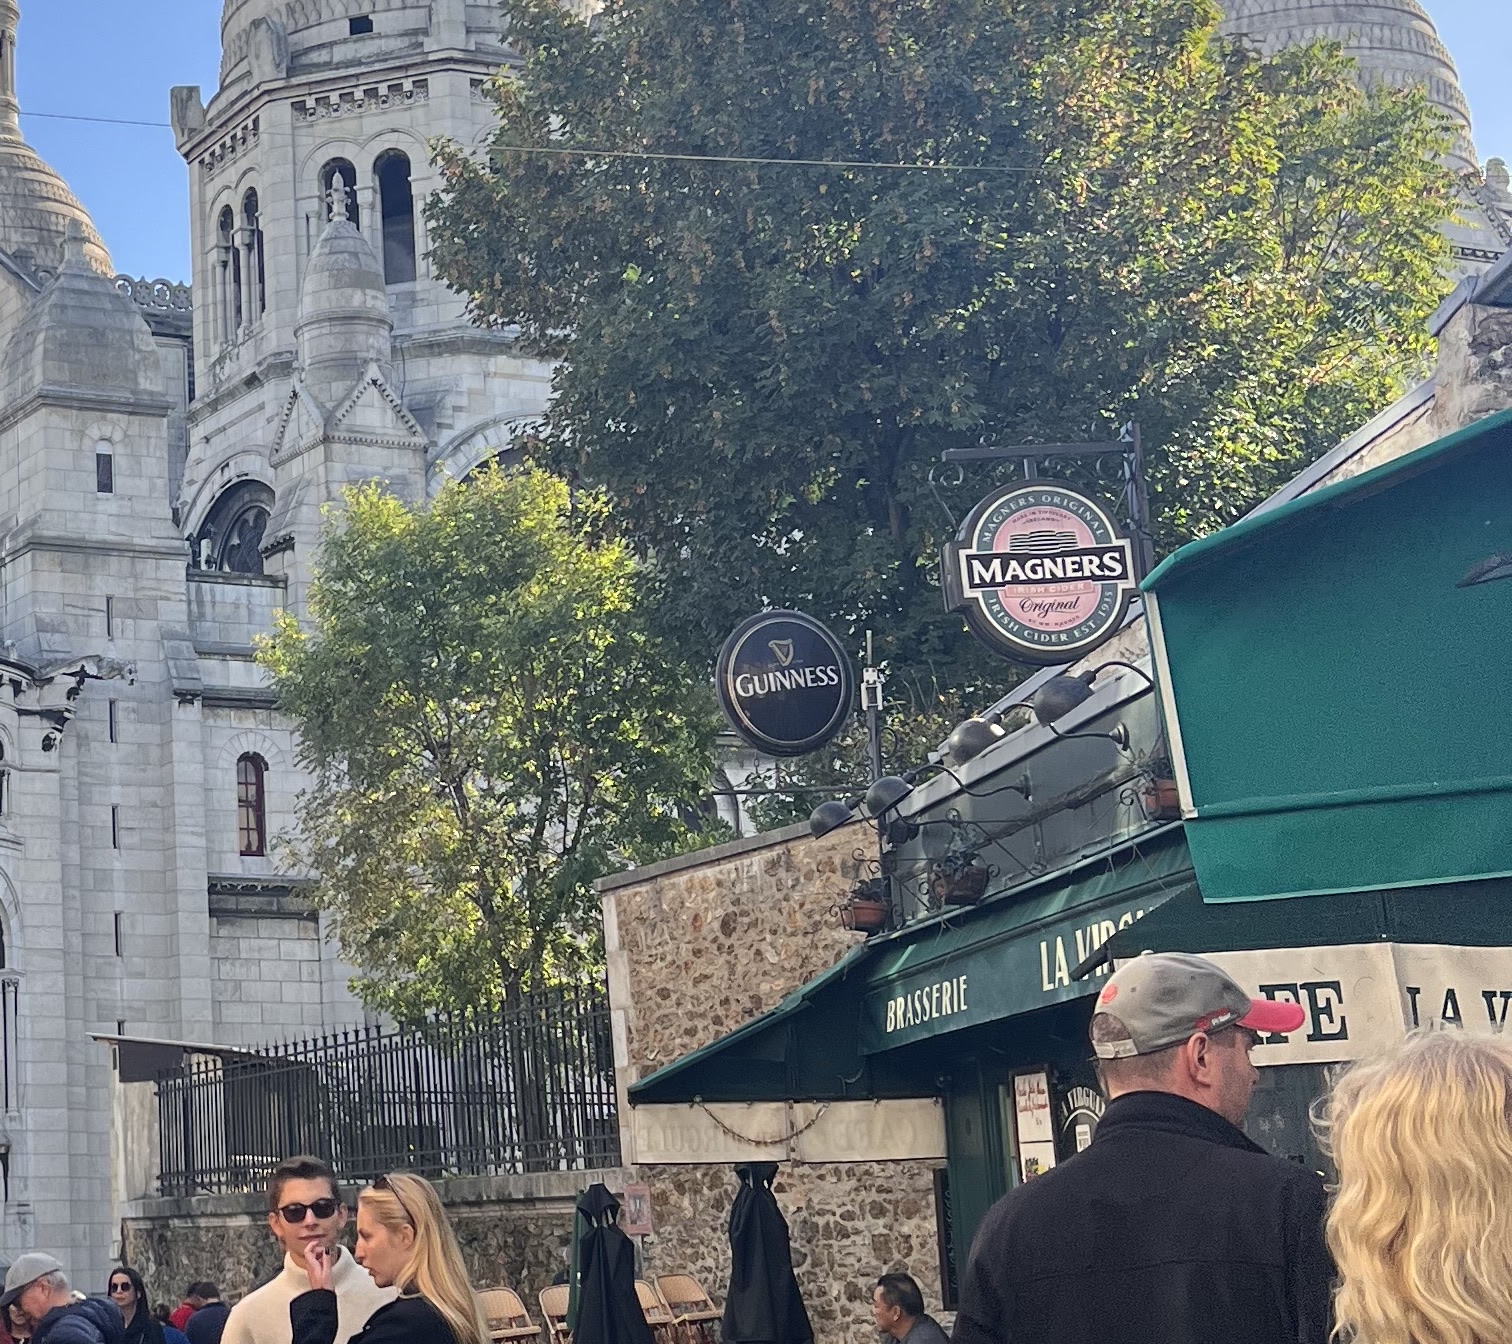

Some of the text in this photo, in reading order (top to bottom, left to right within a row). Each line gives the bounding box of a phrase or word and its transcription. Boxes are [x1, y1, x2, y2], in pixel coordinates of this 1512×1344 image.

[981, 493, 1106, 544] MAGNERS ORIGINAL
[969, 551, 1124, 586] MAGNERS
[1013, 583, 1086, 595] IRISH CIDER
[988, 597, 1021, 633] IRISH
[1023, 629, 1070, 644] CIDER
[1018, 595, 1081, 619] Original
[735, 665, 839, 698] GUINNESS
[1039, 936, 1071, 992] LA
[886, 974, 969, 1033] BRASSERIE
